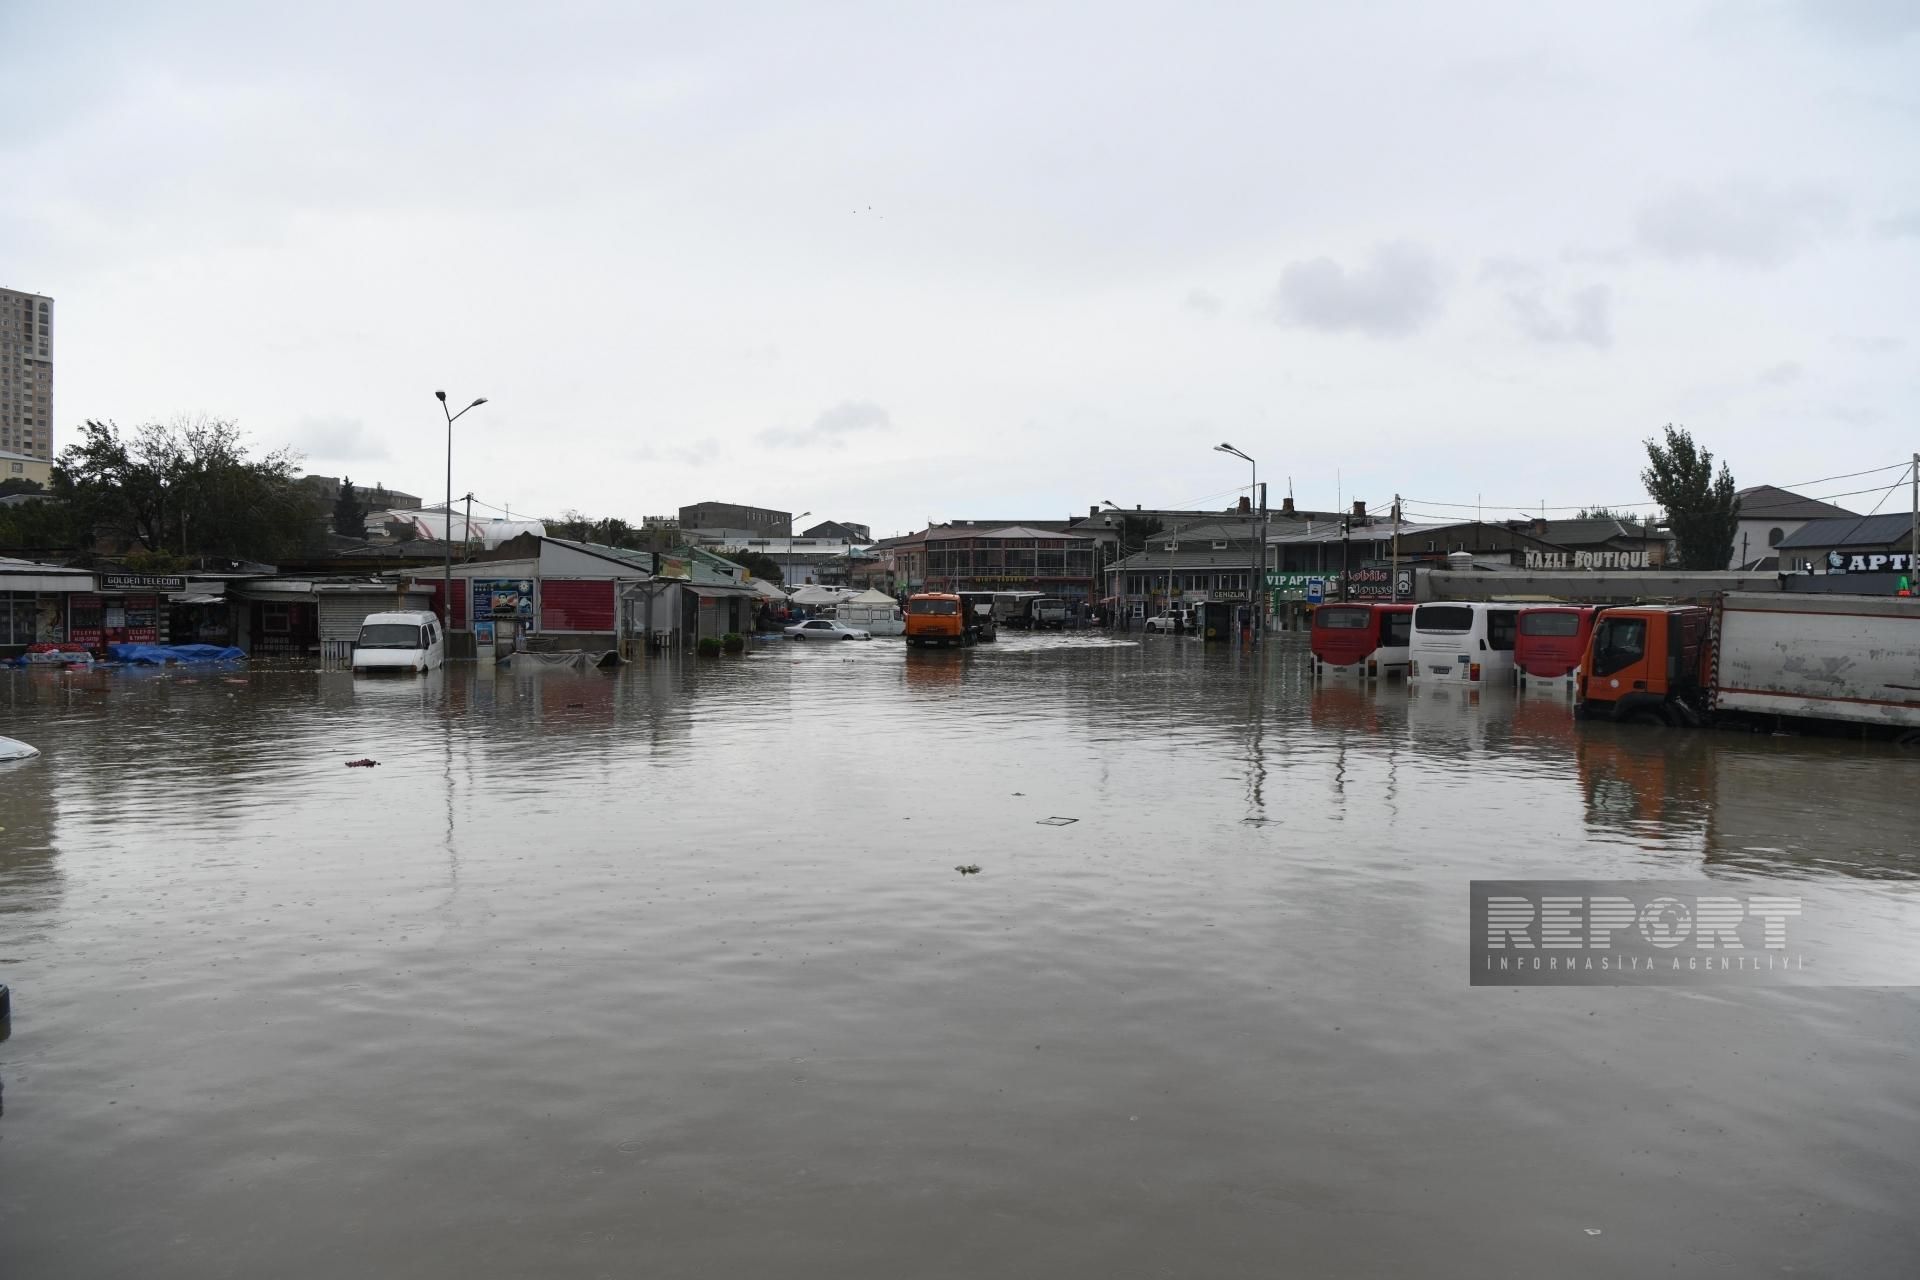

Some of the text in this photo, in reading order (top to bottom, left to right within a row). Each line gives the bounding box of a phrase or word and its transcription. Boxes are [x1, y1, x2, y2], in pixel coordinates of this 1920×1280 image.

[1574, 550, 1650, 570] BOUTIQUE
[107, 576, 180, 586] GOLDEN TELECOM
[1266, 575, 1287, 585] VIP
